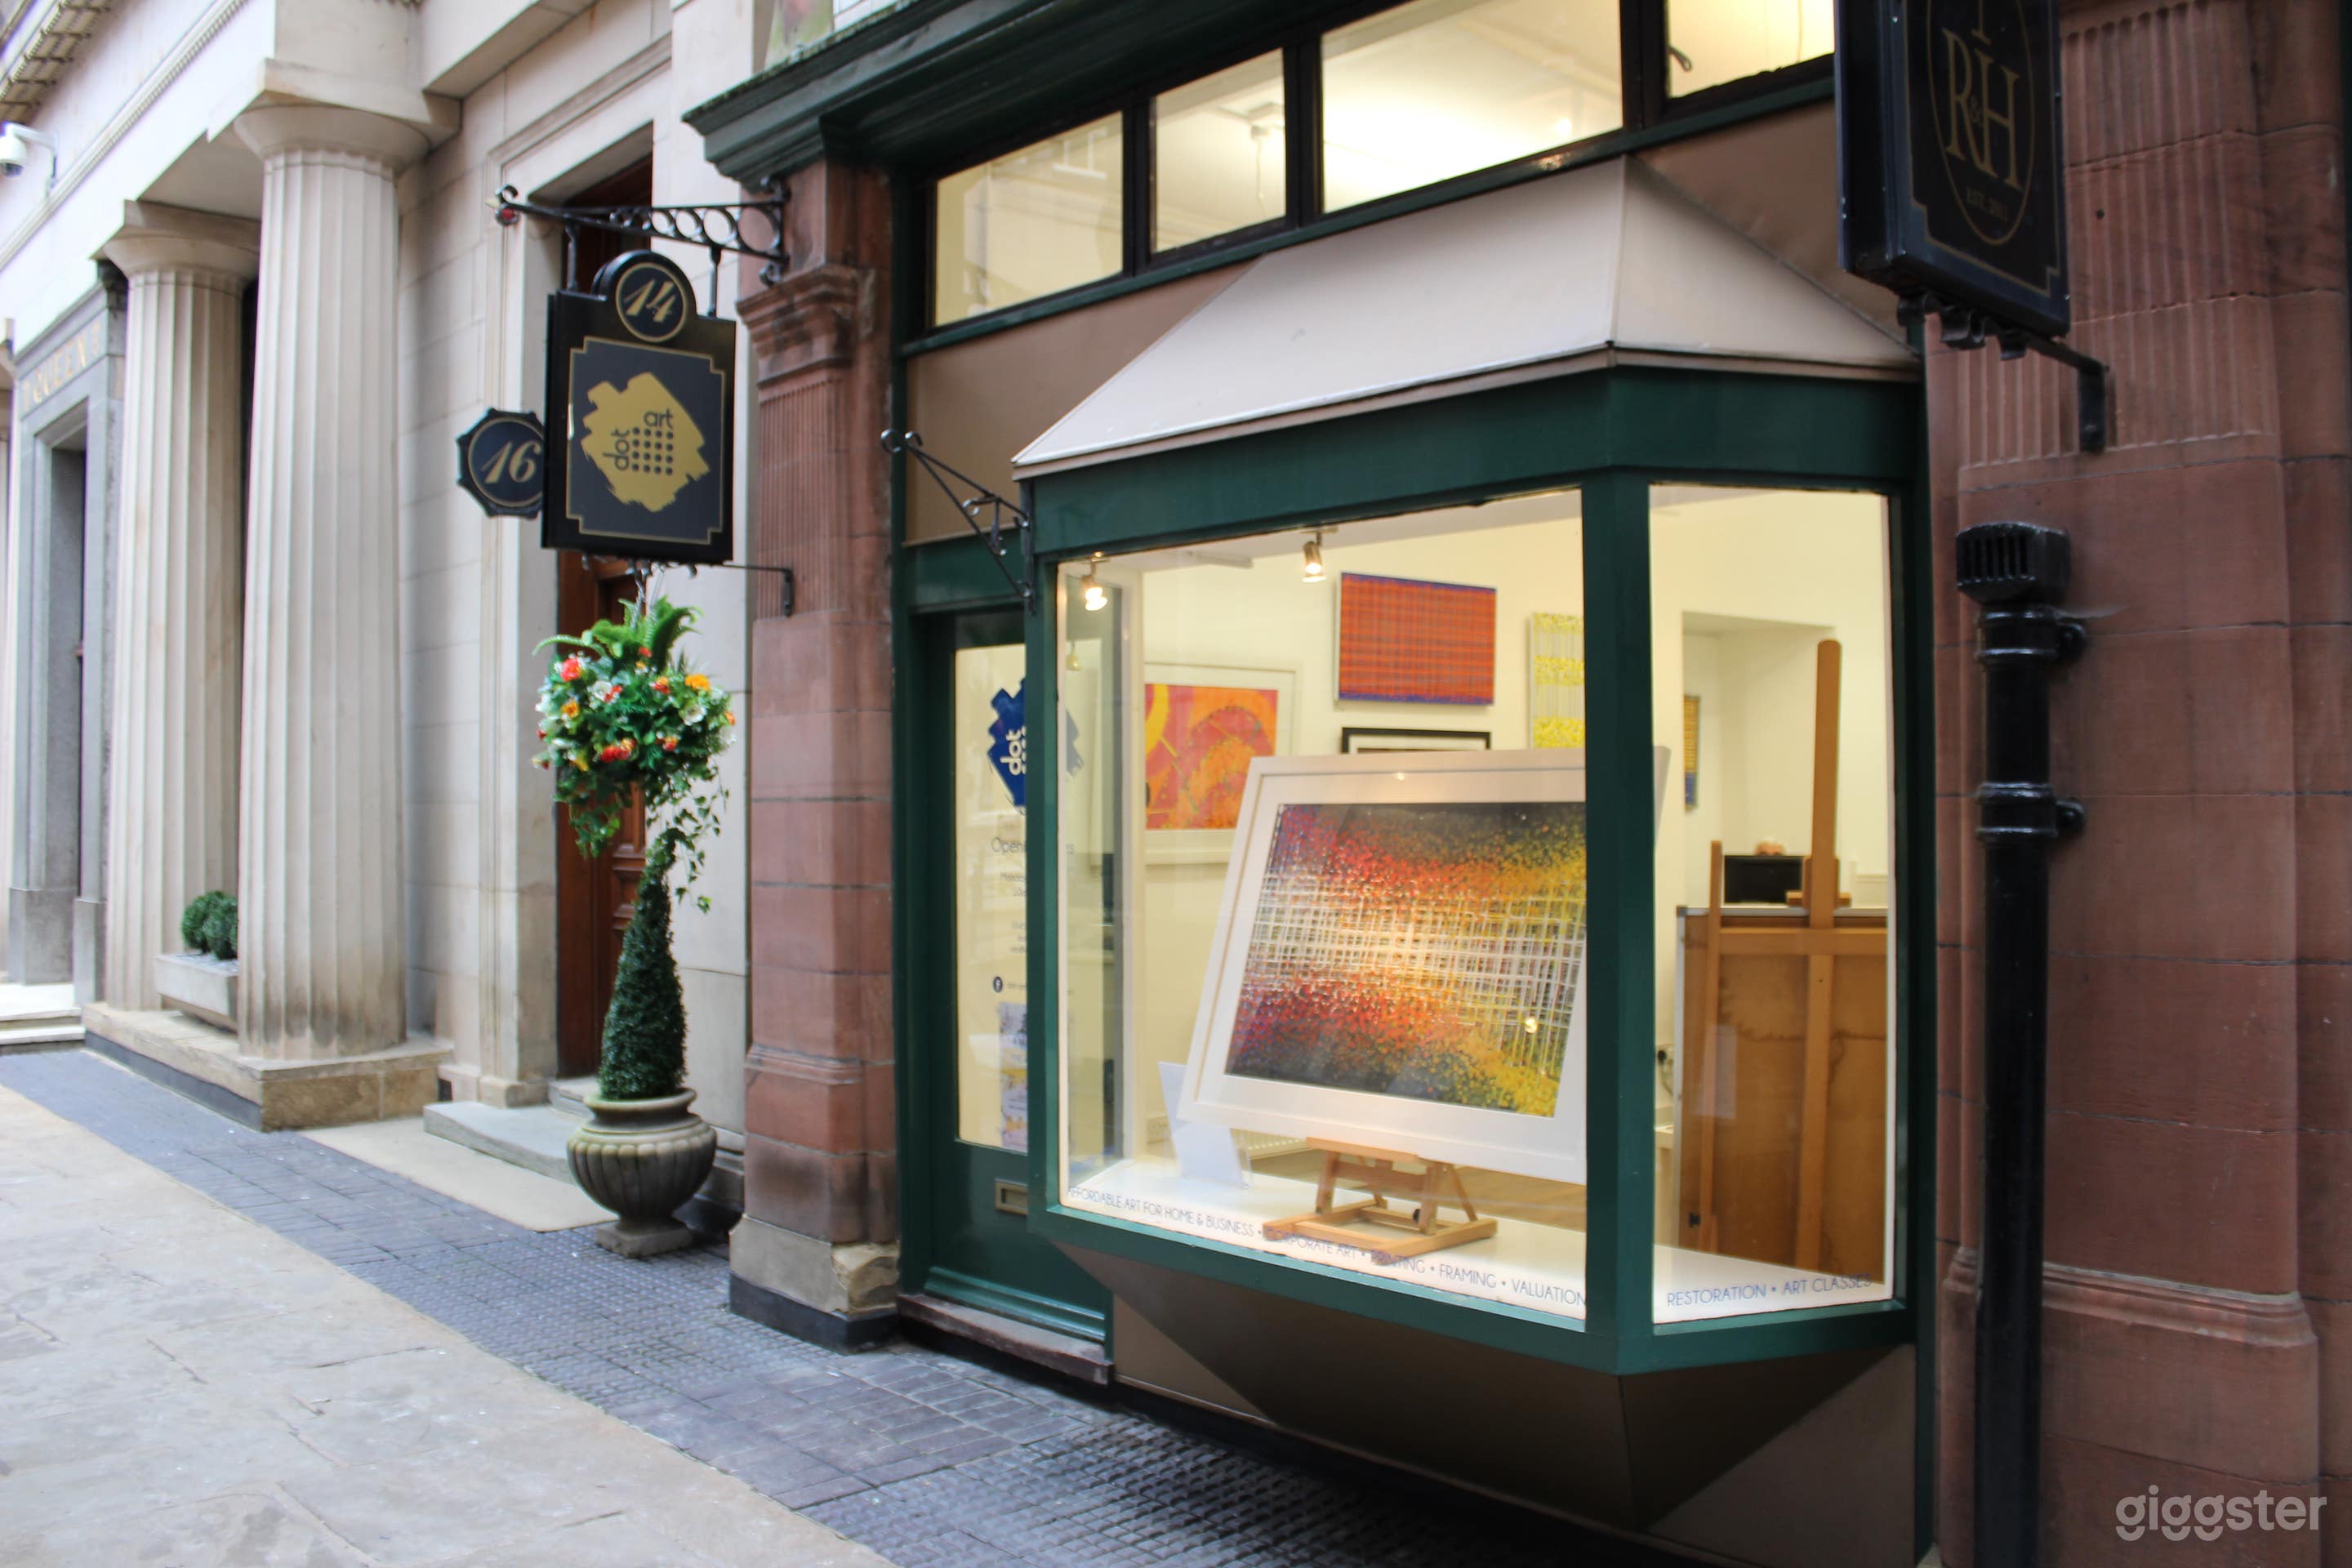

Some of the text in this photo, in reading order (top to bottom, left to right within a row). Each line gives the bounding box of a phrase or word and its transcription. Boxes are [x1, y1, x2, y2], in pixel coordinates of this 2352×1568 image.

[623, 279, 676, 323] 14
[643, 408, 674, 430] art
[480, 439, 542, 483] 16
[602, 427, 632, 471] dot
[999, 728, 1022, 776] dot
[1124, 1198, 1142, 1212] ART
[1143, 1201, 1163, 1217] FOR
[1165, 1208, 1195, 1224] HOME
[1196, 1214, 1205, 1226] &
[1205, 1214, 1255, 1237] BUSINESS
[1266, 1227, 1333, 1255] CORPORATE
[1336, 1244, 1356, 1259] ART
[1440, 1263, 1497, 1289] FRAMING
[1667, 1272, 1873, 1307] RESTORATION ART CLASSES
